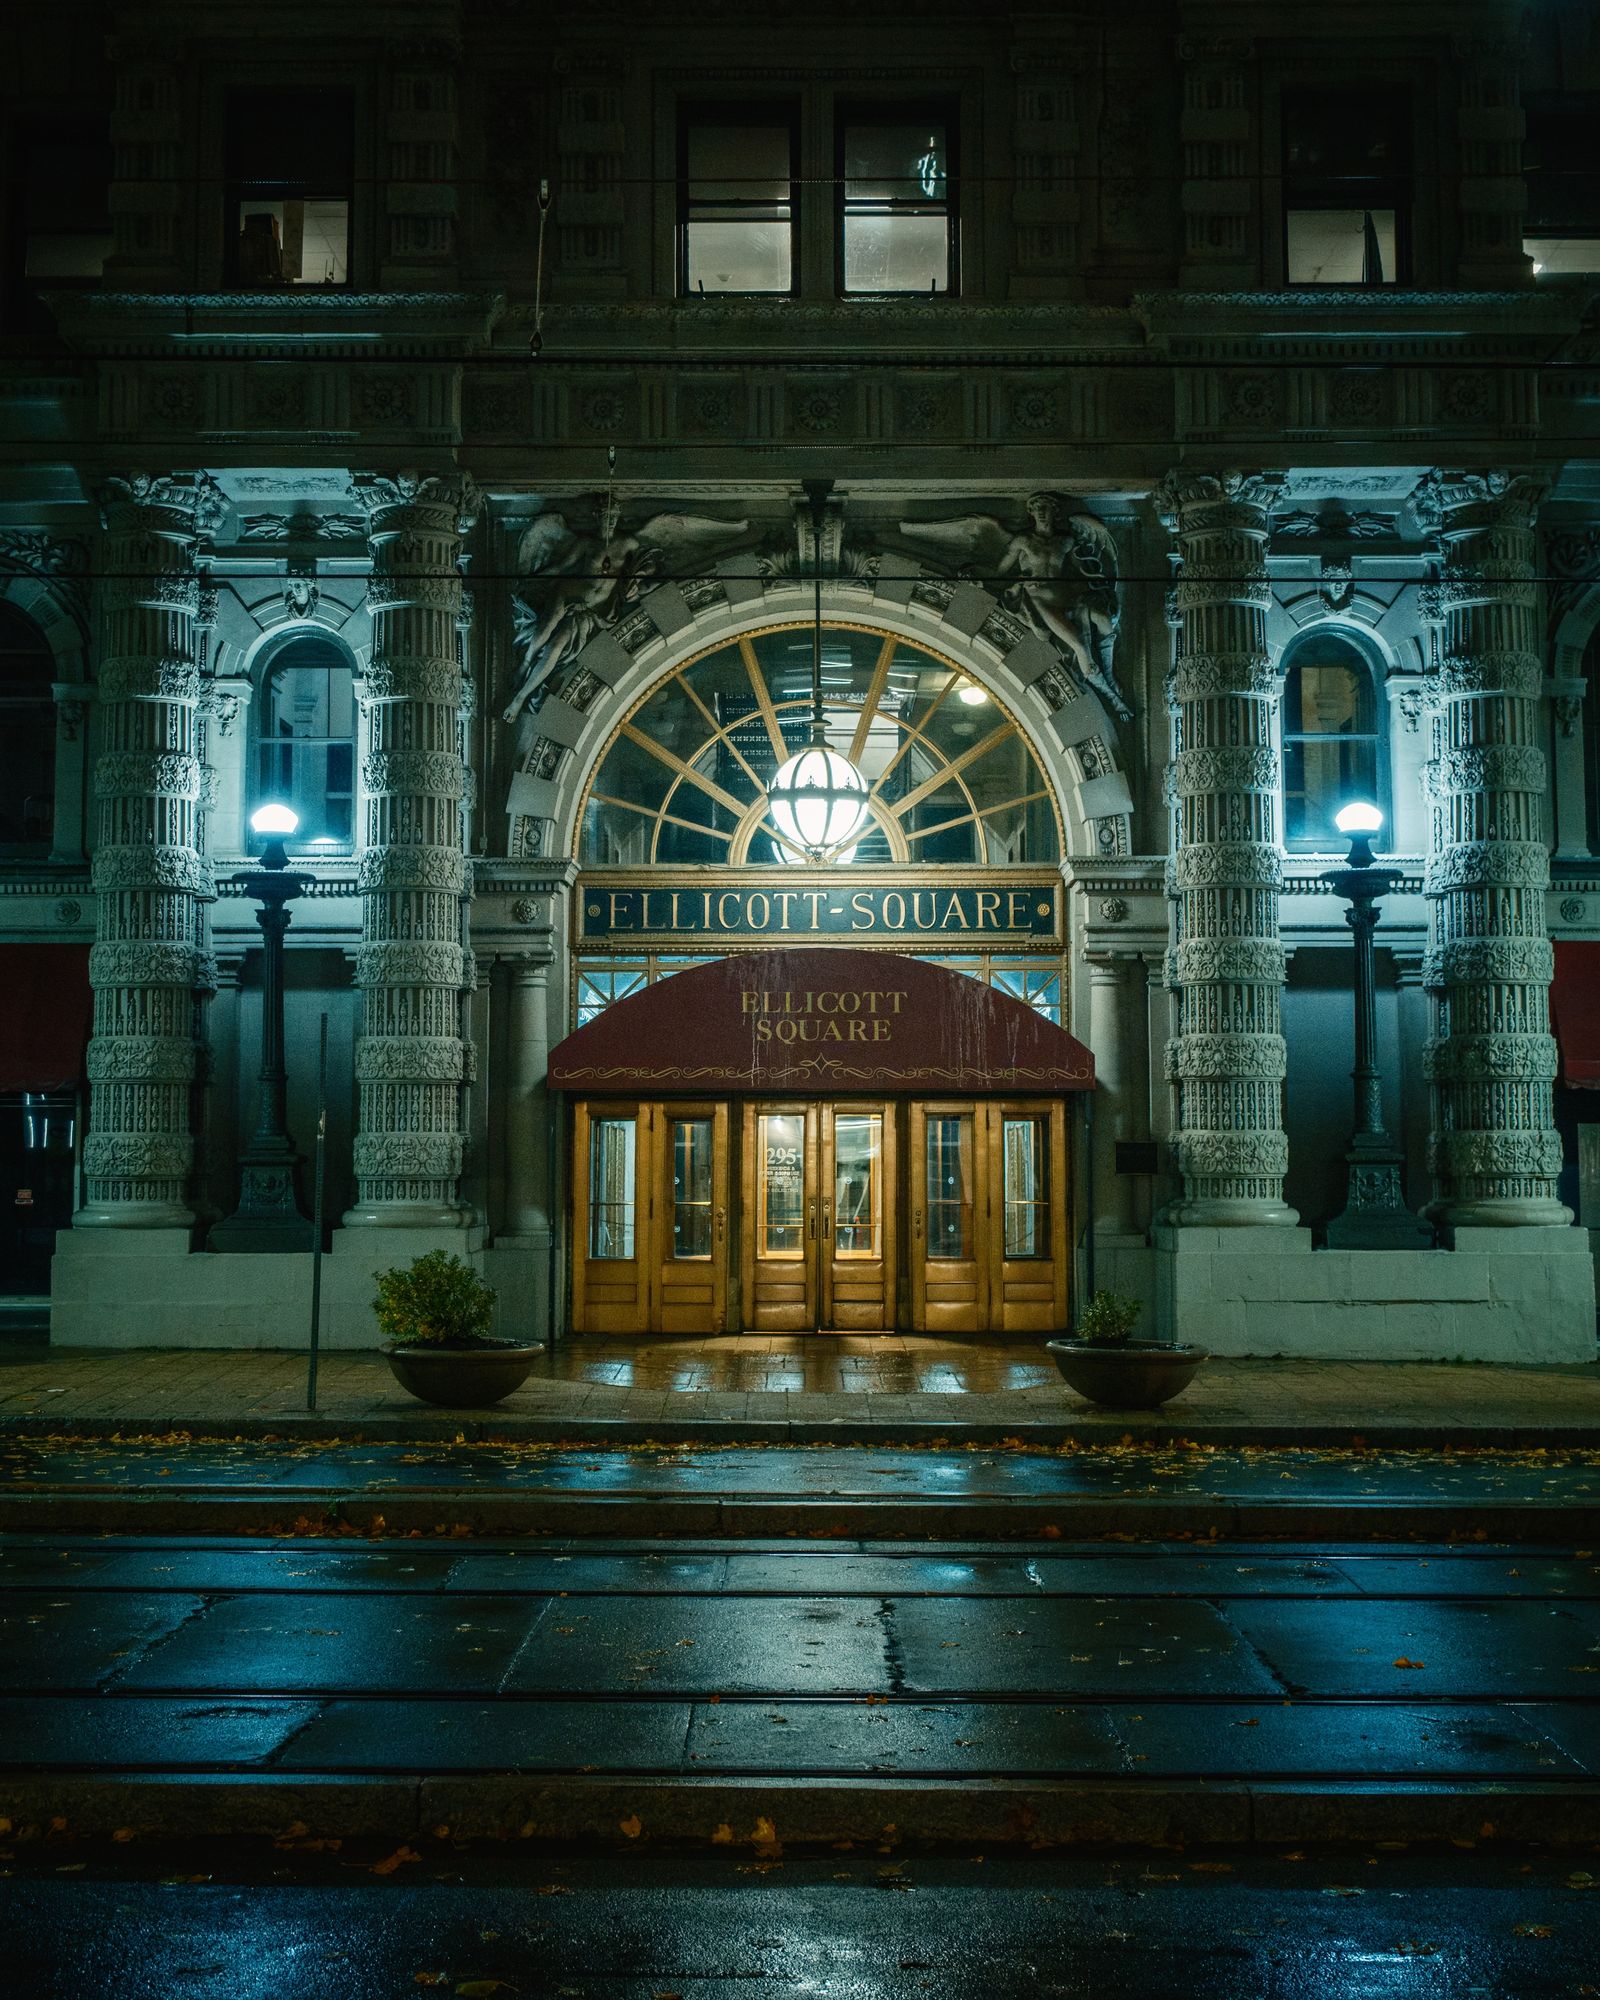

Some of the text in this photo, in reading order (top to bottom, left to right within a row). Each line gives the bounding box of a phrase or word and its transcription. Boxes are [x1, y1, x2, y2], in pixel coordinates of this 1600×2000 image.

[741, 991, 908, 1014] ELLICOTT
[757, 1019, 892, 1045] SQUARE
[766, 1147, 797, 1165] 295
